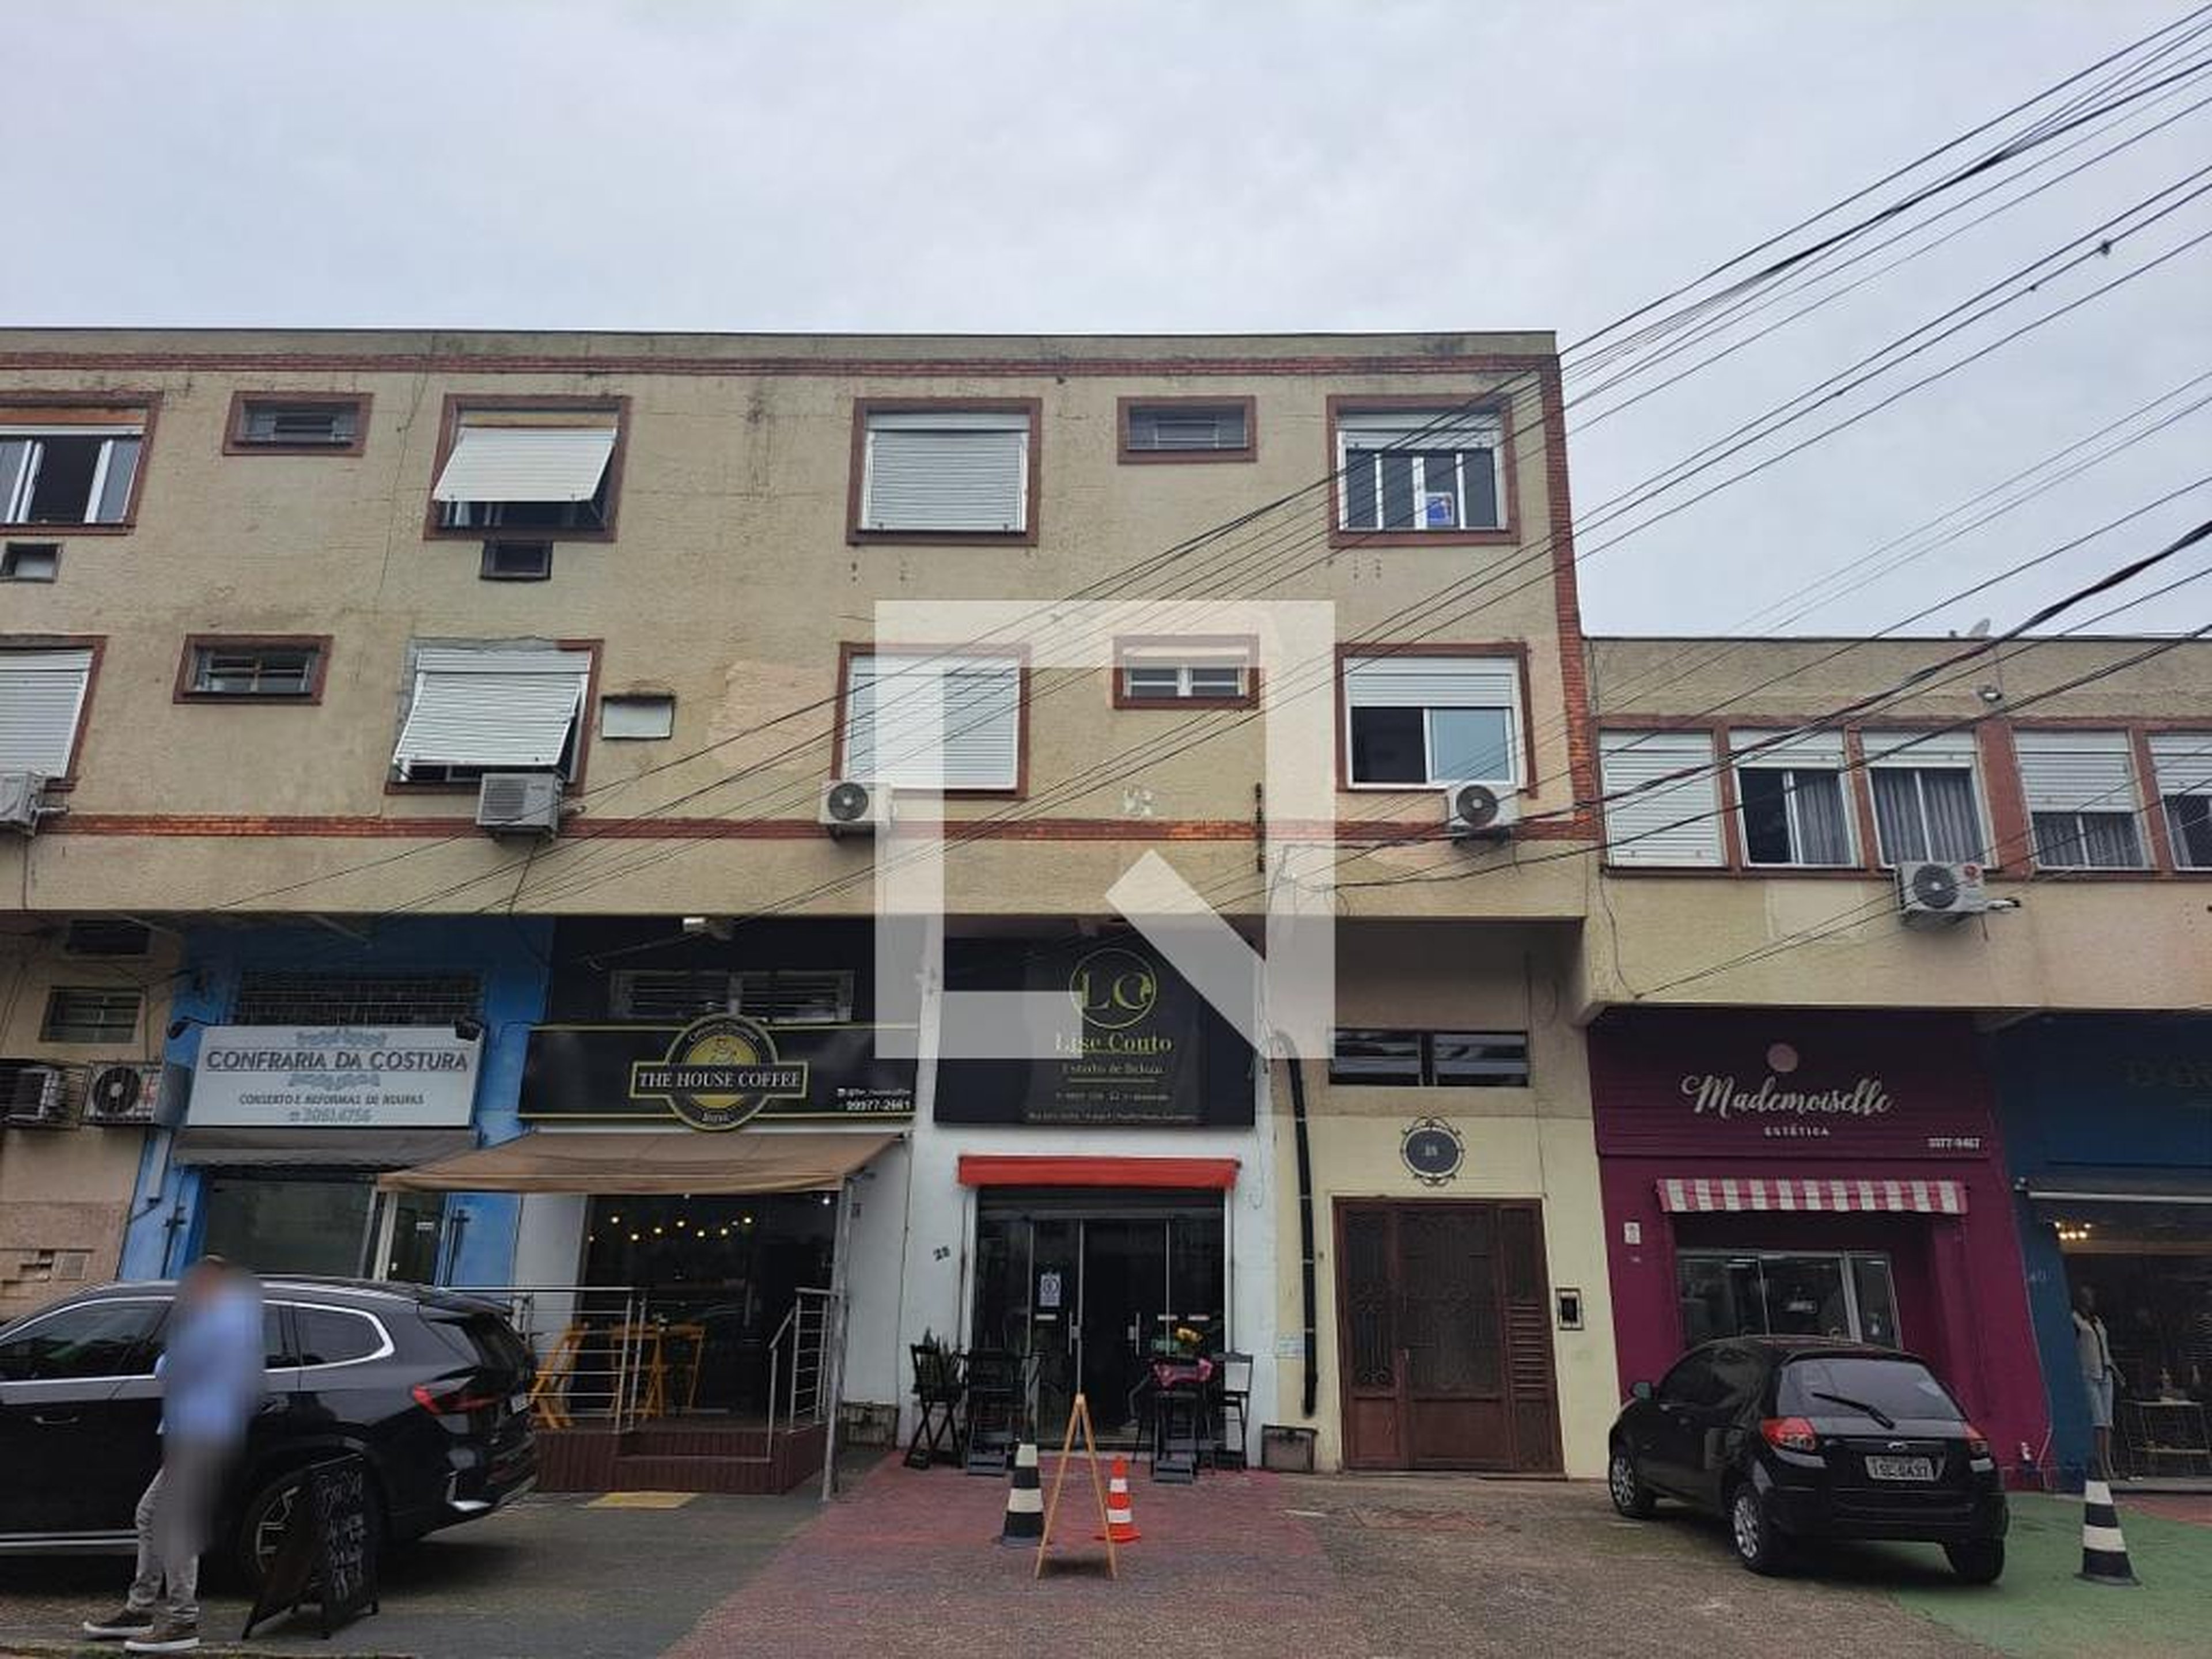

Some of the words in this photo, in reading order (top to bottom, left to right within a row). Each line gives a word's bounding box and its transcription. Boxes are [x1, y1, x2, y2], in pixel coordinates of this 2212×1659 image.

[206, 1050, 327, 1071] CONFRARIA
[334, 1050, 362, 1070] DA
[369, 1050, 468, 1071] COSTURA
[638, 1071, 672, 1088] THE
[676, 1071, 733, 1088] HOUSE
[737, 1071, 801, 1088] COFFEE
[1681, 1075, 1893, 1119] Mademoiselle
